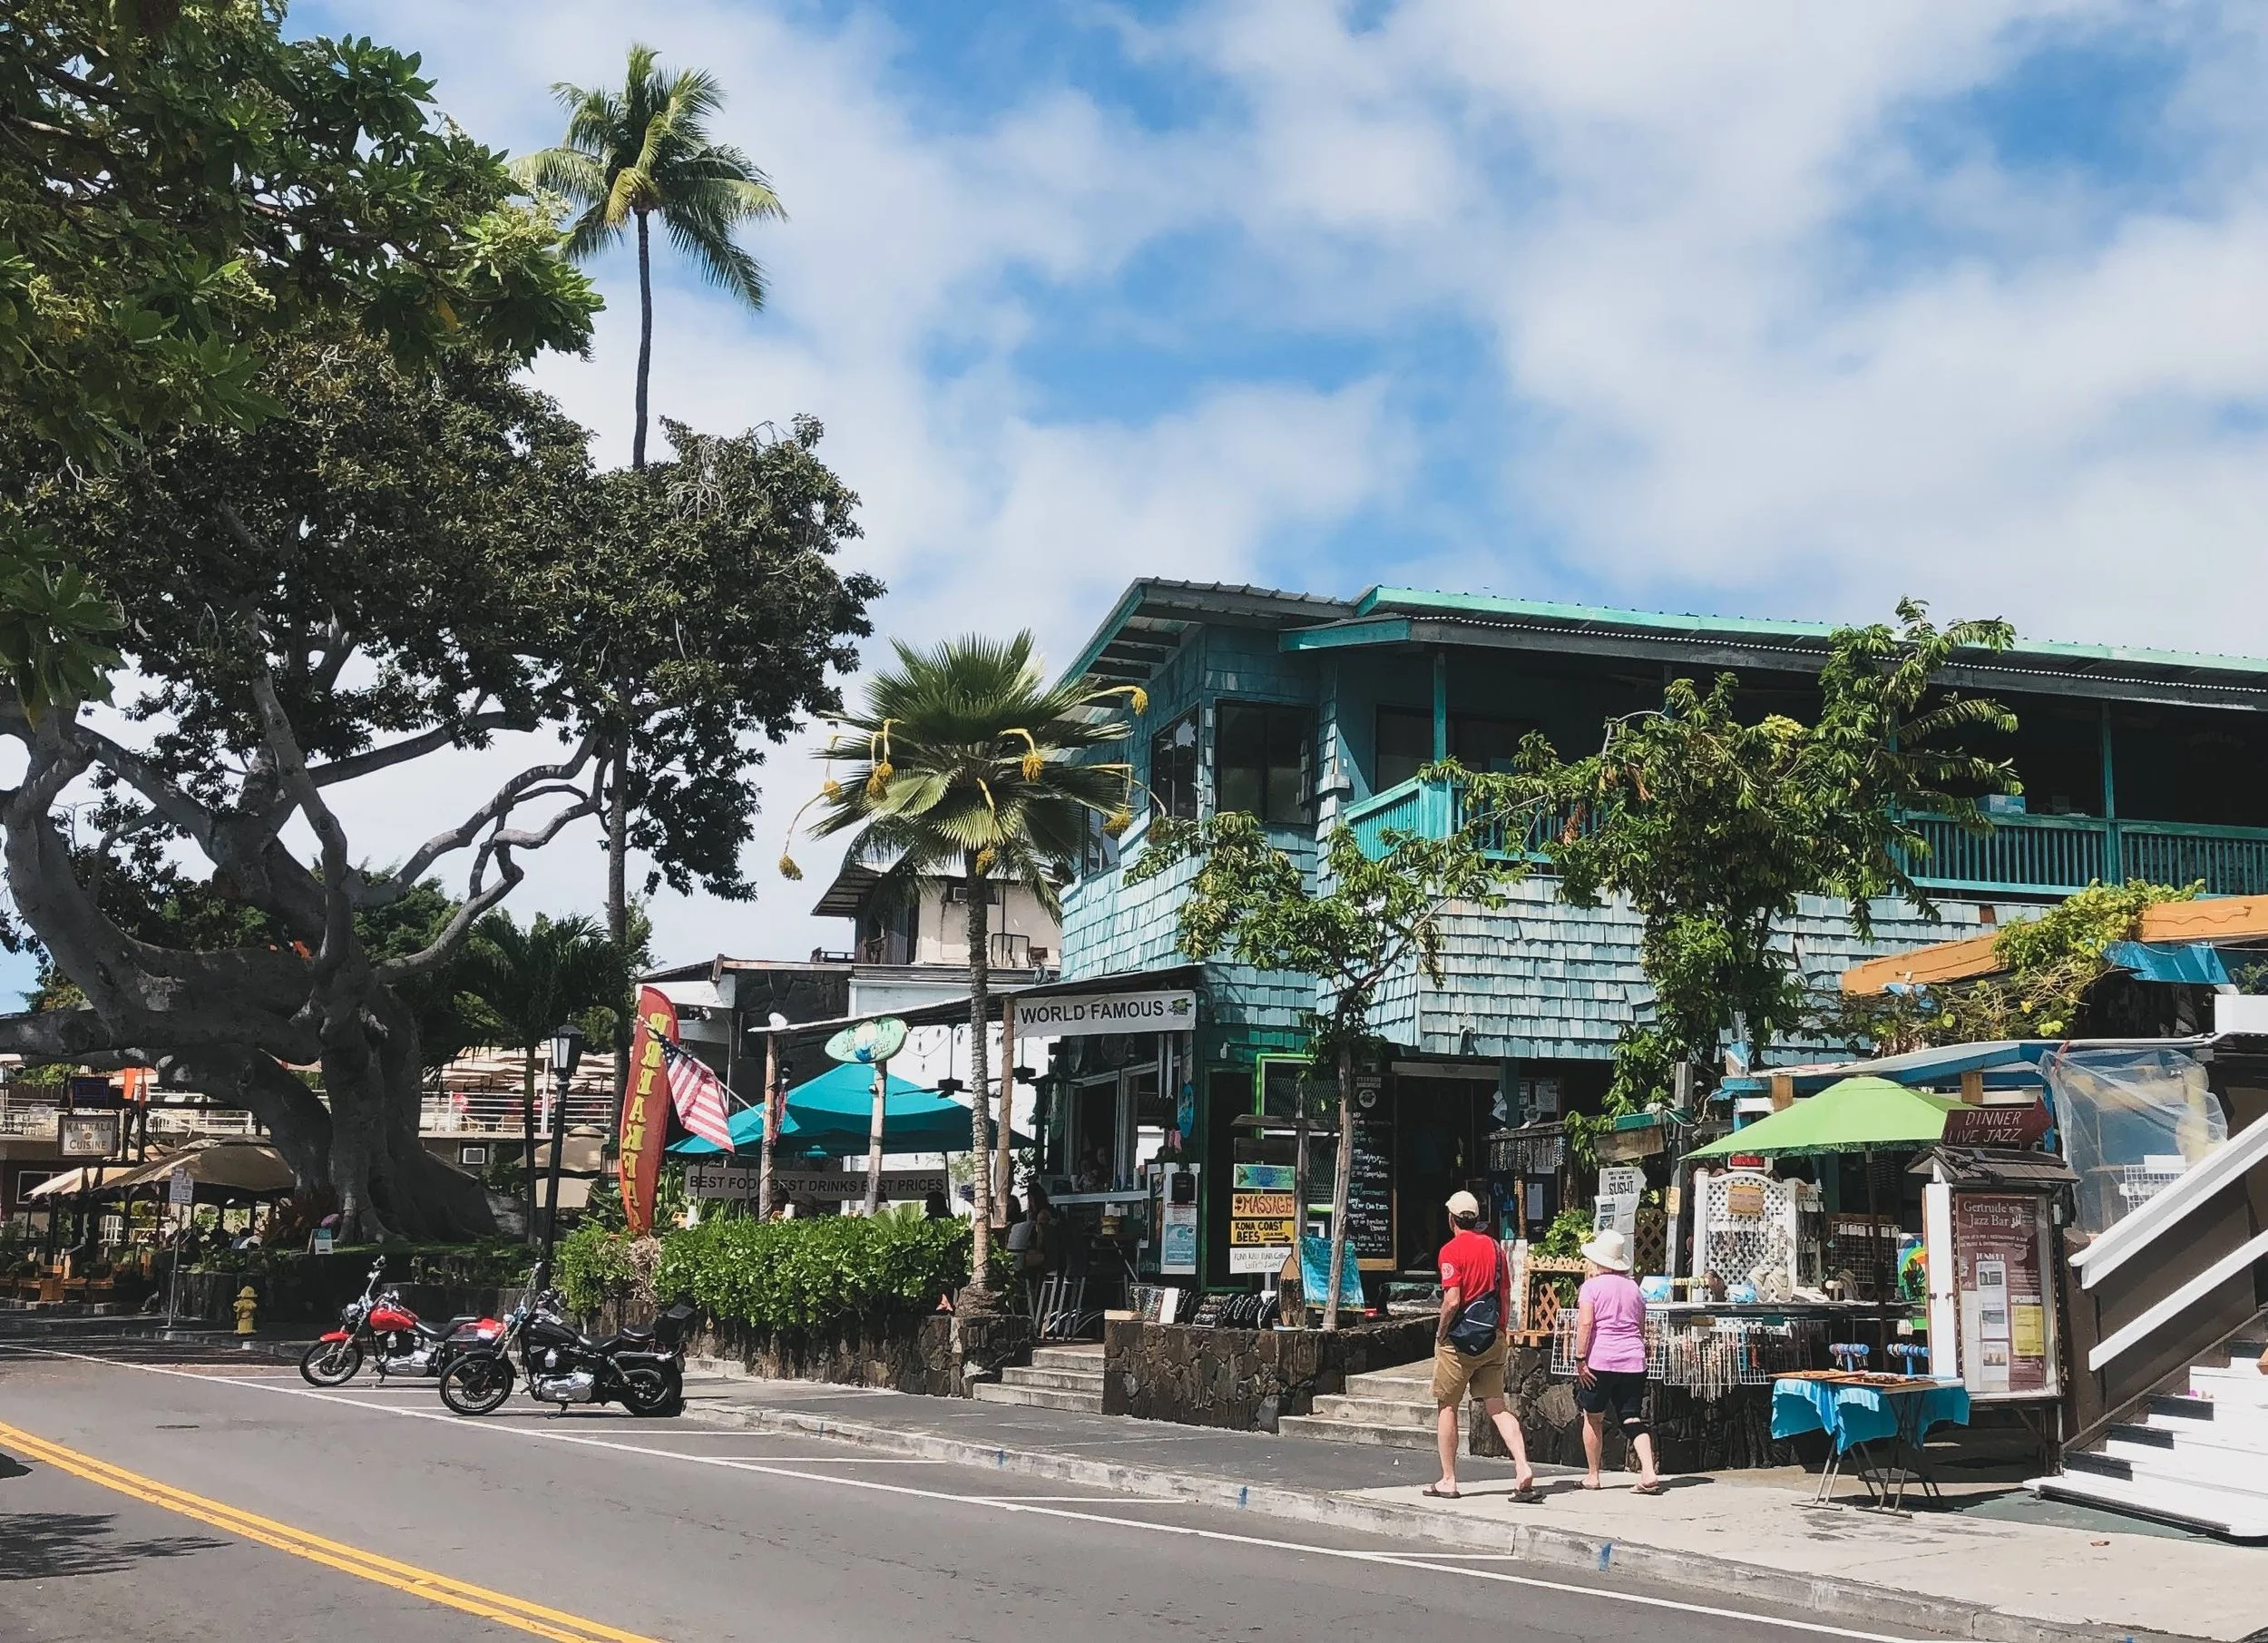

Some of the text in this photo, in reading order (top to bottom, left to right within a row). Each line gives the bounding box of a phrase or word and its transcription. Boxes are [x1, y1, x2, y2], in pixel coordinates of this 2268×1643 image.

[1021, 1001, 1164, 1024] WORLD FAMOUS
[1965, 1111, 2021, 1126] DINNER
[1948, 1128, 2023, 1143] LIVE JAZZ
[69, 1139, 107, 1150] CUISINE
[689, 1176, 725, 1189] BEST
[728, 1177, 760, 1190] FOO
[808, 1179, 857, 1192] DRINKS
[897, 1178, 944, 1192] PRICES
[1608, 1180, 1635, 1195] SUSHI
[1242, 1196, 1292, 1214] MASSAGE
[1235, 1220, 1284, 1231] KONA COAST
[1969, 1214, 1989, 1228] Jazz
[1991, 1214, 2009, 1226] Bar
[1237, 1231, 1260, 1243] BEES
